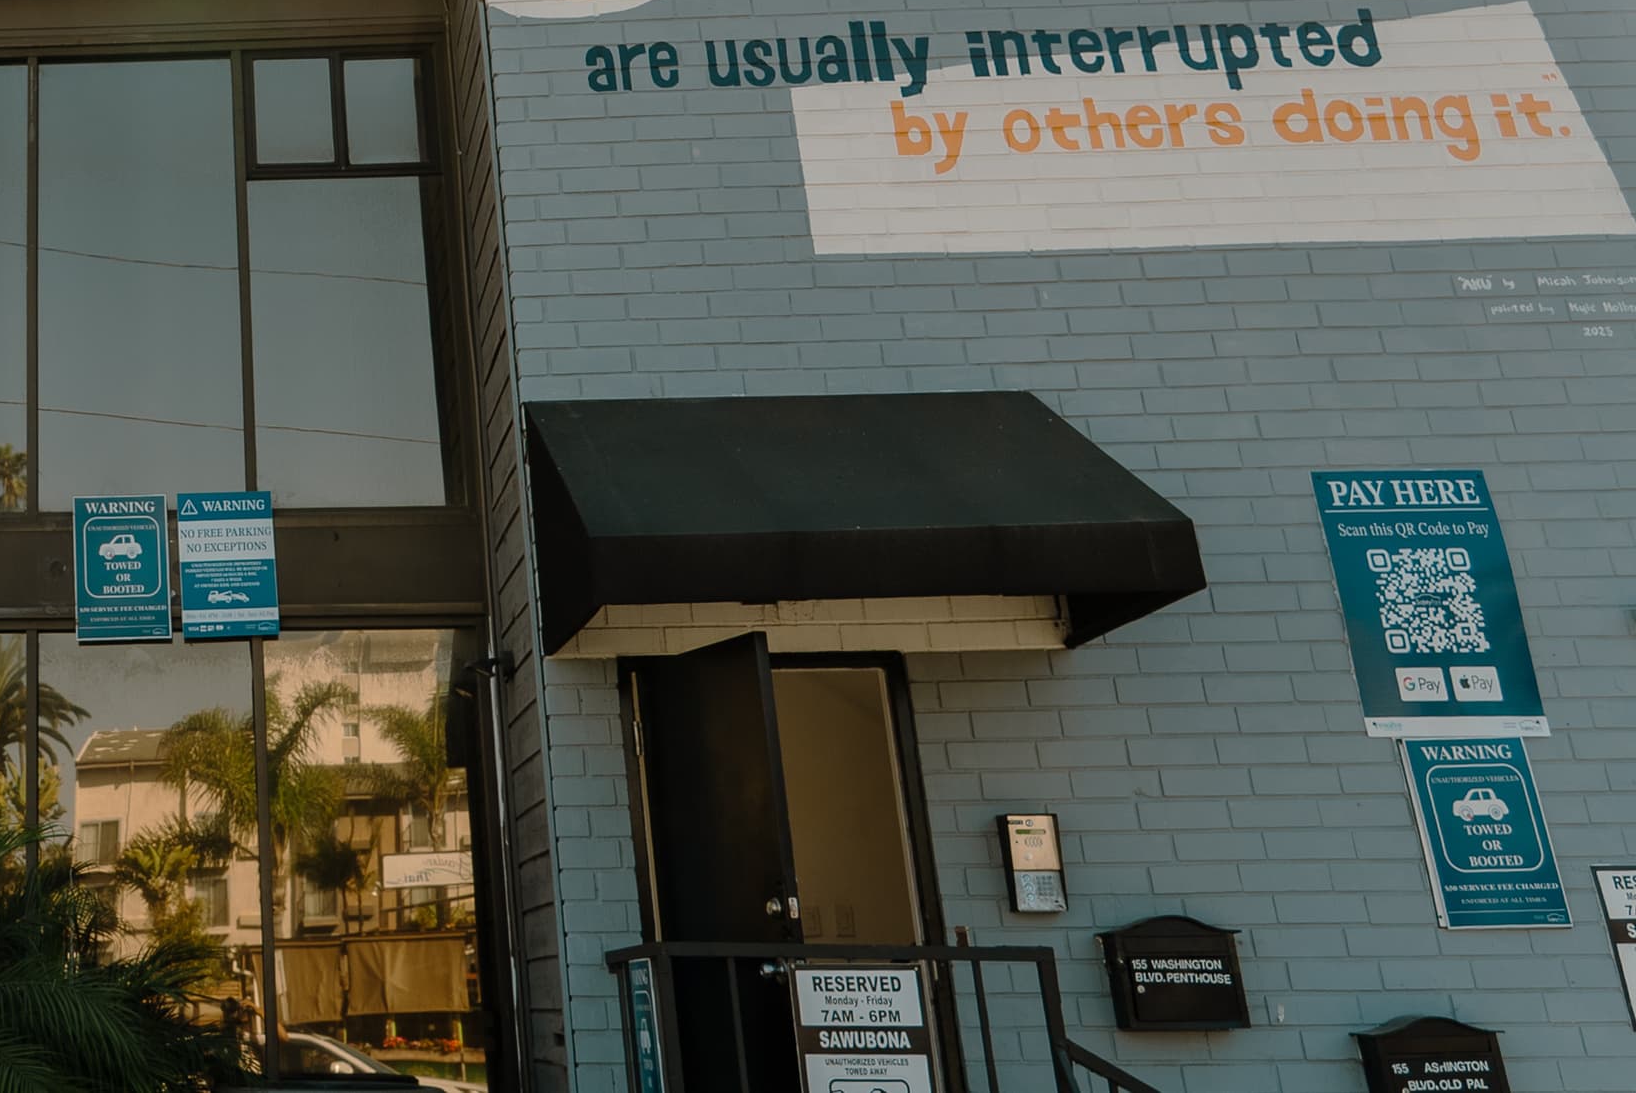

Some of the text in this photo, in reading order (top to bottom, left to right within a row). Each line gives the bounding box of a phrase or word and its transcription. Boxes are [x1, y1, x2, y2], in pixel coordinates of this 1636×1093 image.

[585, 8, 1382, 98] are usually interrupted
[891, 100, 968, 175] by
[1003, 97, 1245, 153] others
[1272, 88, 1481, 162] doing
[1327, 479, 1481, 506] PAY HERE
[85, 501, 155, 514] WARNING
[202, 499, 265, 512] WARNING
[180, 527, 271, 538] NO FREE PARKING
[1337, 521, 1489, 539] Scan this QR Code to Pay
[186, 541, 267, 553] NO EXCEPTIONS
[104, 561, 141, 571] TOWED
[115, 573, 131, 582] OR
[103, 585, 144, 595] BOOTED
[1419, 677, 1441, 694] Pay
[1471, 675, 1493, 693] Pay
[1421, 744, 1513, 761] WARNING
[1463, 824, 1512, 836] TOWED
[1482, 840, 1503, 851] OR
[1469, 855, 1524, 867] BOOTED
[1515, 882, 1559, 890] CHARGED
[1131, 959, 1223, 970] 155 WASHINGTON
[811, 975, 902, 992] RESERVED
[1166, 972, 1232, 985] PENTHOUSE
[825, 995, 858, 1007] Monday
[866, 995, 893, 1007] Friday
[821, 1010, 854, 1023] 7AM
[869, 1010, 901, 1023] 6PM
[819, 1030, 911, 1048] SAWUBONA
[825, 1058, 909, 1066] UNAUTHORIZED VEHICLES
[1391, 1063, 1409, 1074] 155
[1440, 1079, 1462, 1091] OLD
[1466, 1078, 1489, 1090] PAL
